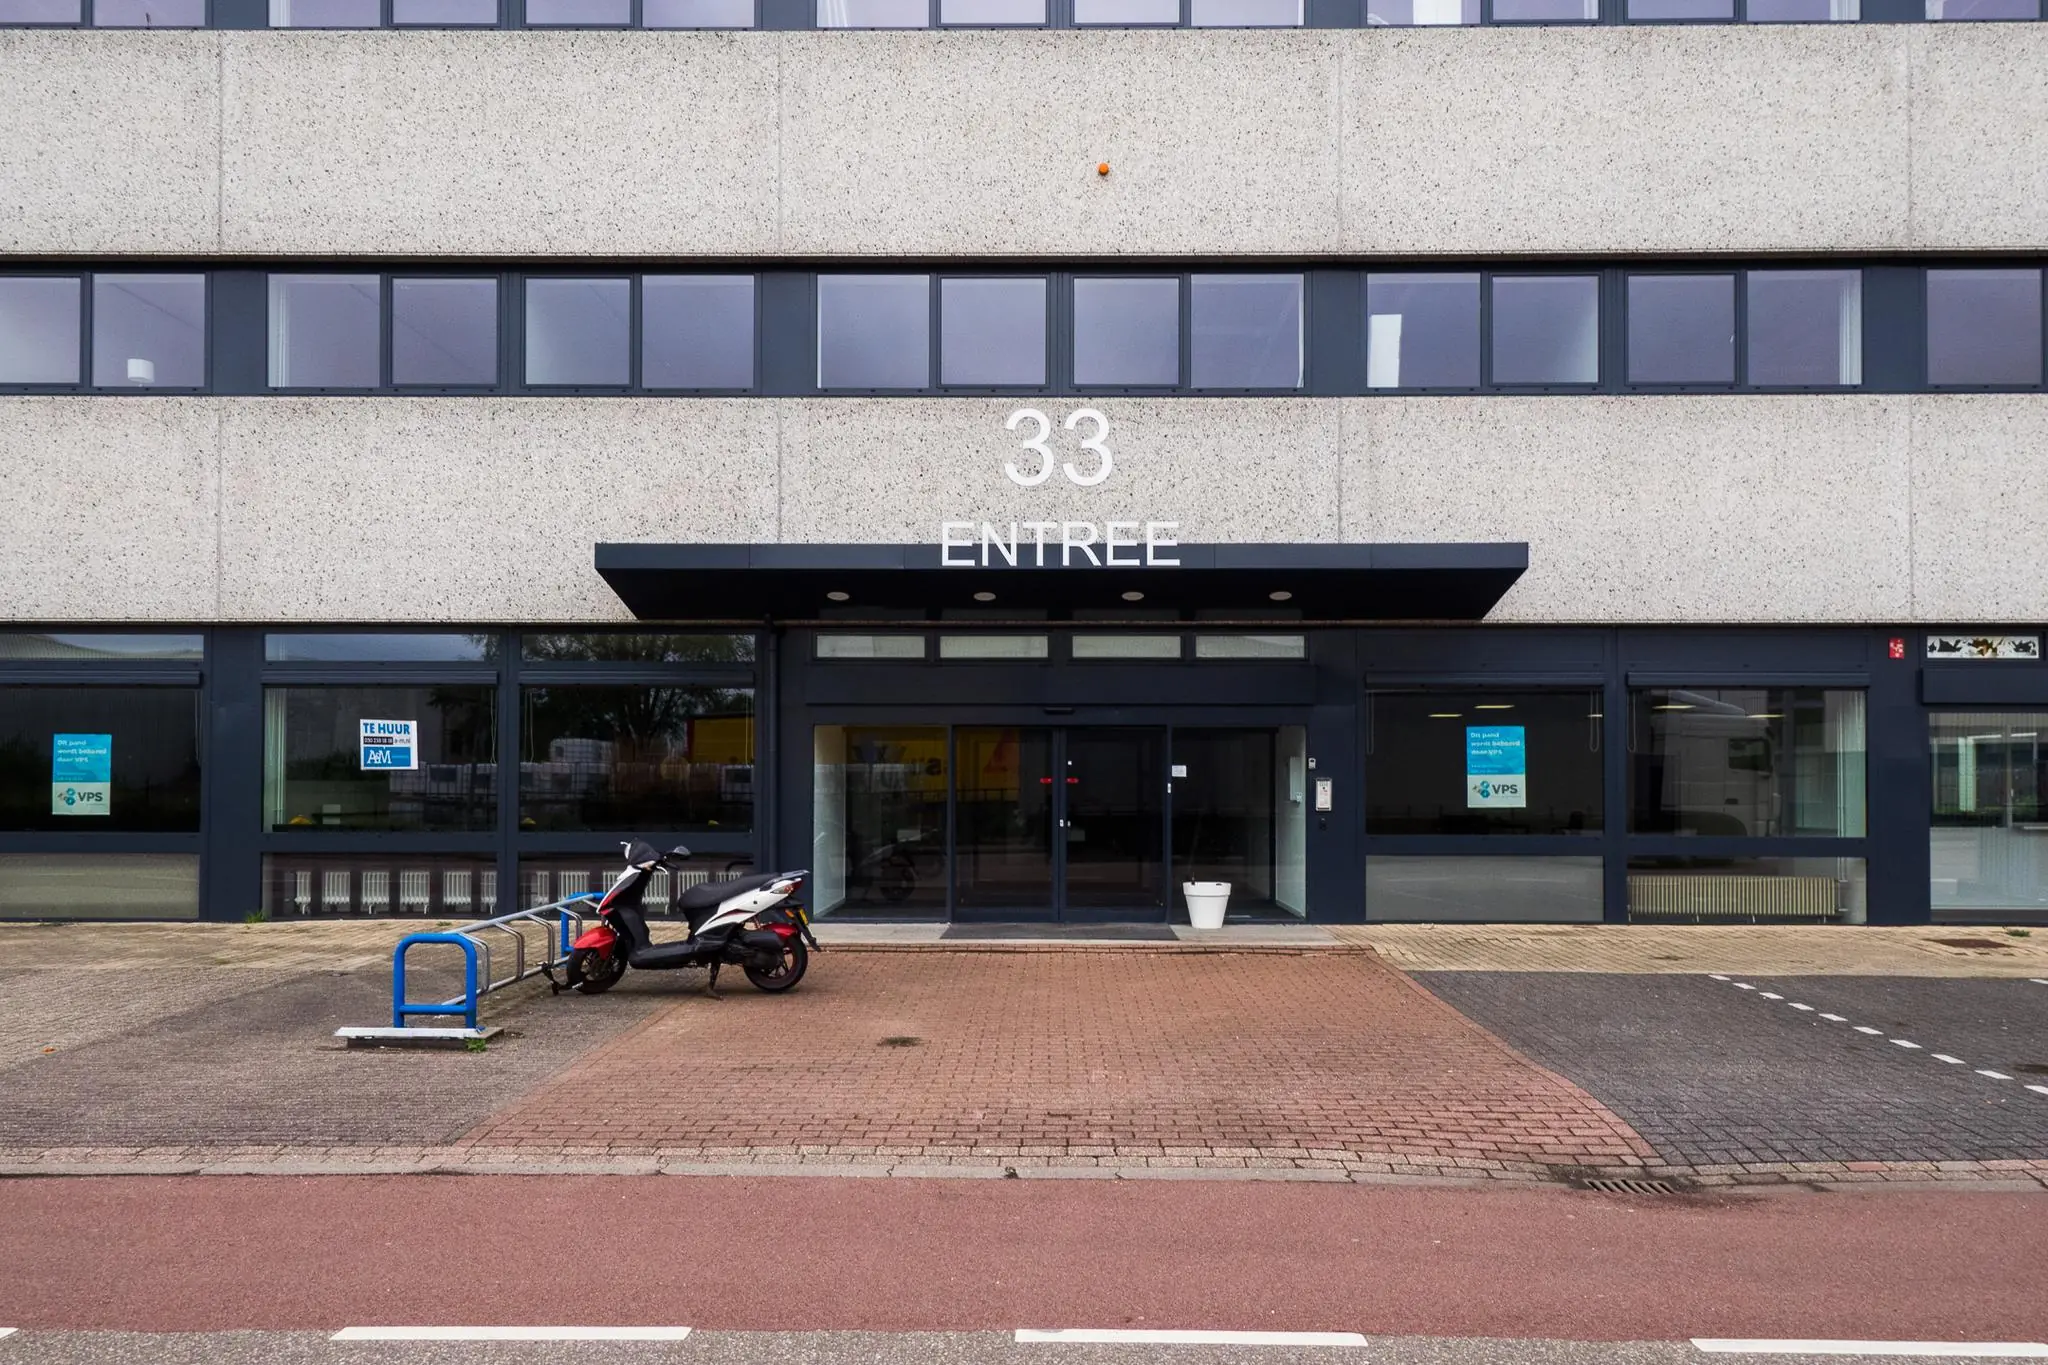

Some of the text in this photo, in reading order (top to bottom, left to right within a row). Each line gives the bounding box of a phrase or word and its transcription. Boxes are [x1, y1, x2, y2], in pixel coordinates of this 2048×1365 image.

[1004, 408, 1113, 487] 33
[942, 521, 1181, 567] ENTREE
[363, 723, 410, 735] TE HUUR
[1492, 784, 1519, 795] VPS
[77, 791, 104, 802] VPS
